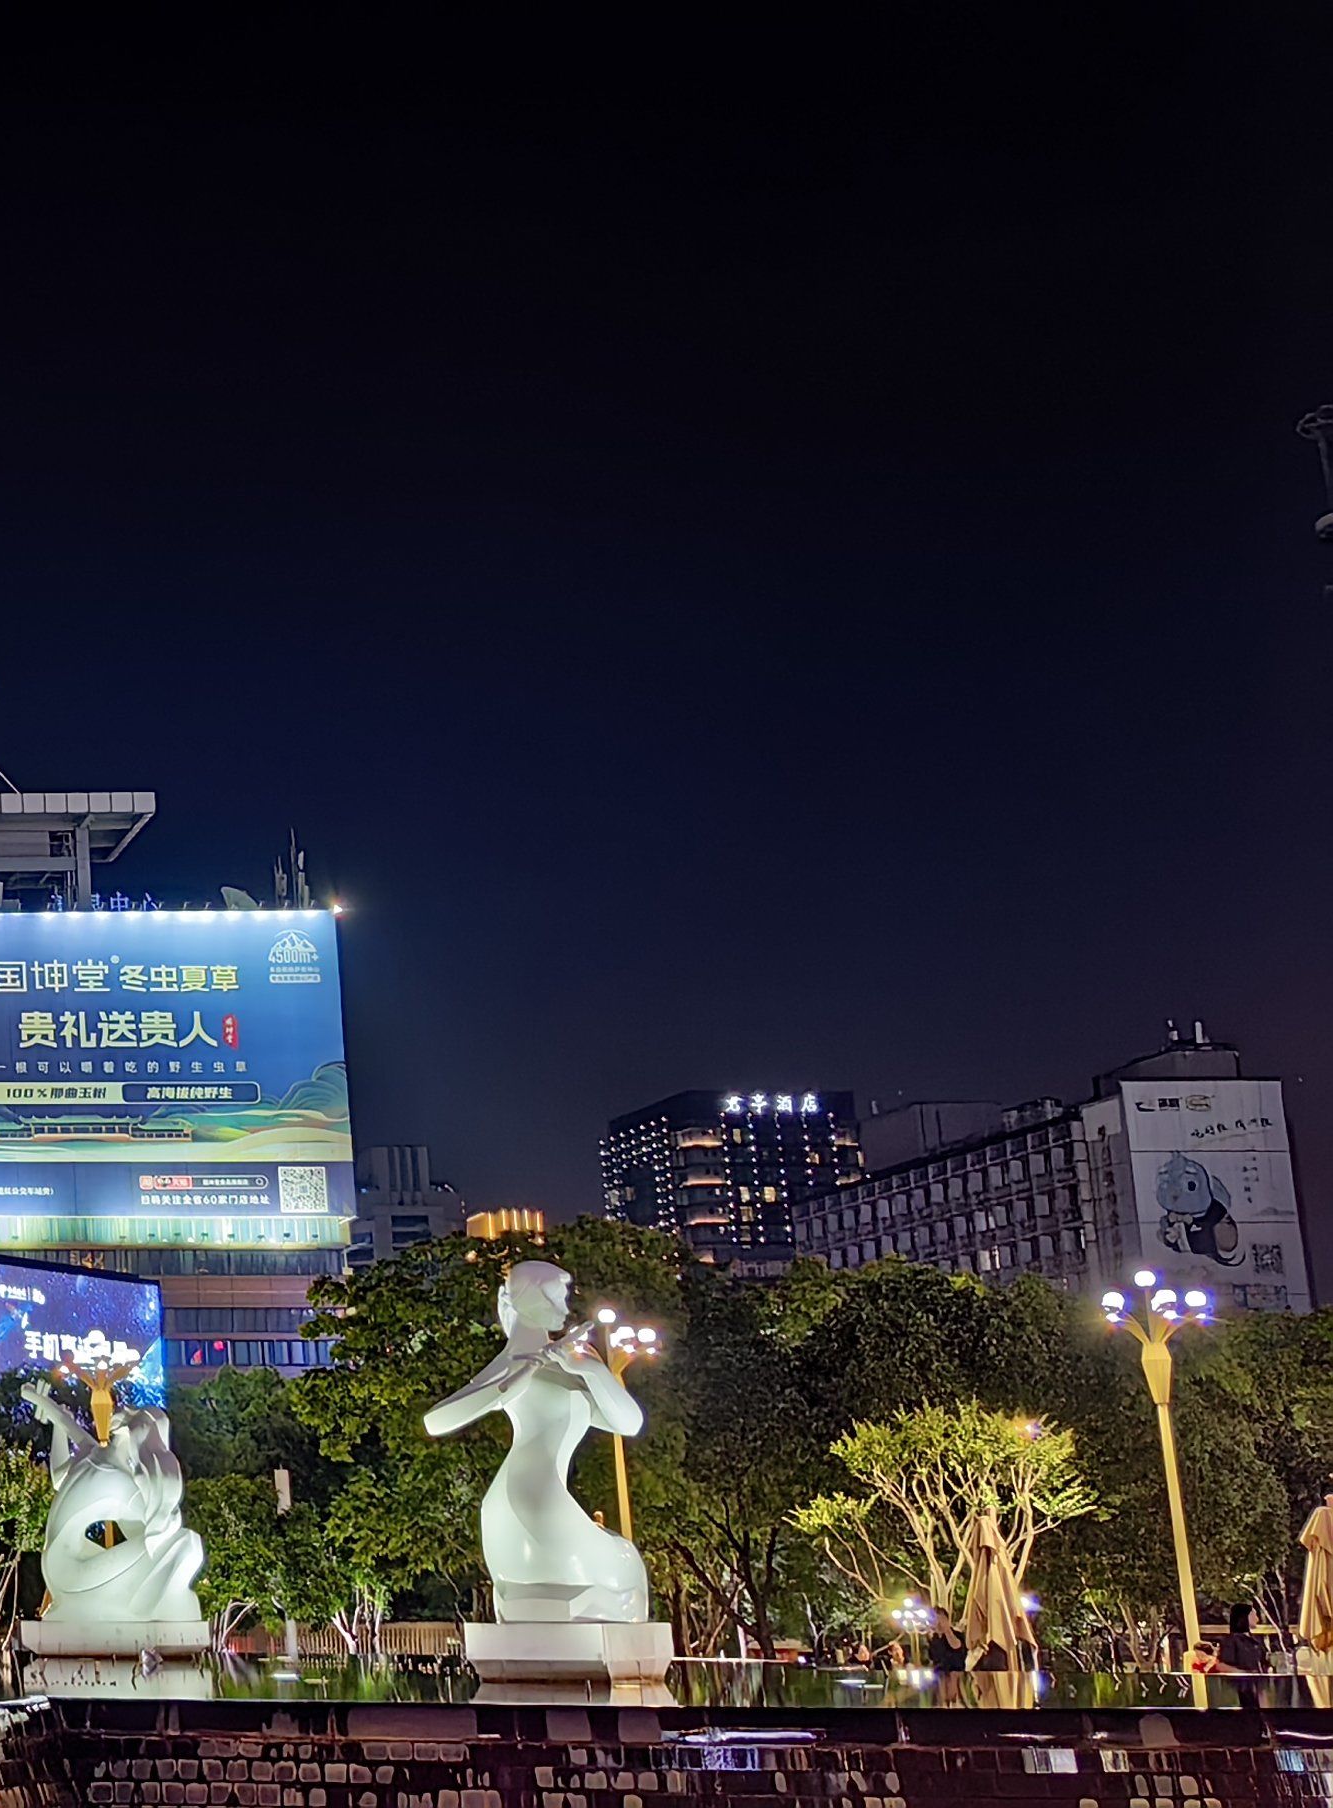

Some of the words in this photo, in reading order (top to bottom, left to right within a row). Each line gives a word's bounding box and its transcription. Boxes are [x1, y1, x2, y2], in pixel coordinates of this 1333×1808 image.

[18, 1011, 219, 1048] 贵礼送贵人
[146, 1086, 233, 1100] 高海拔纯野生
[140, 1194, 270, 1205] 扫码关注全省60家门店地址
